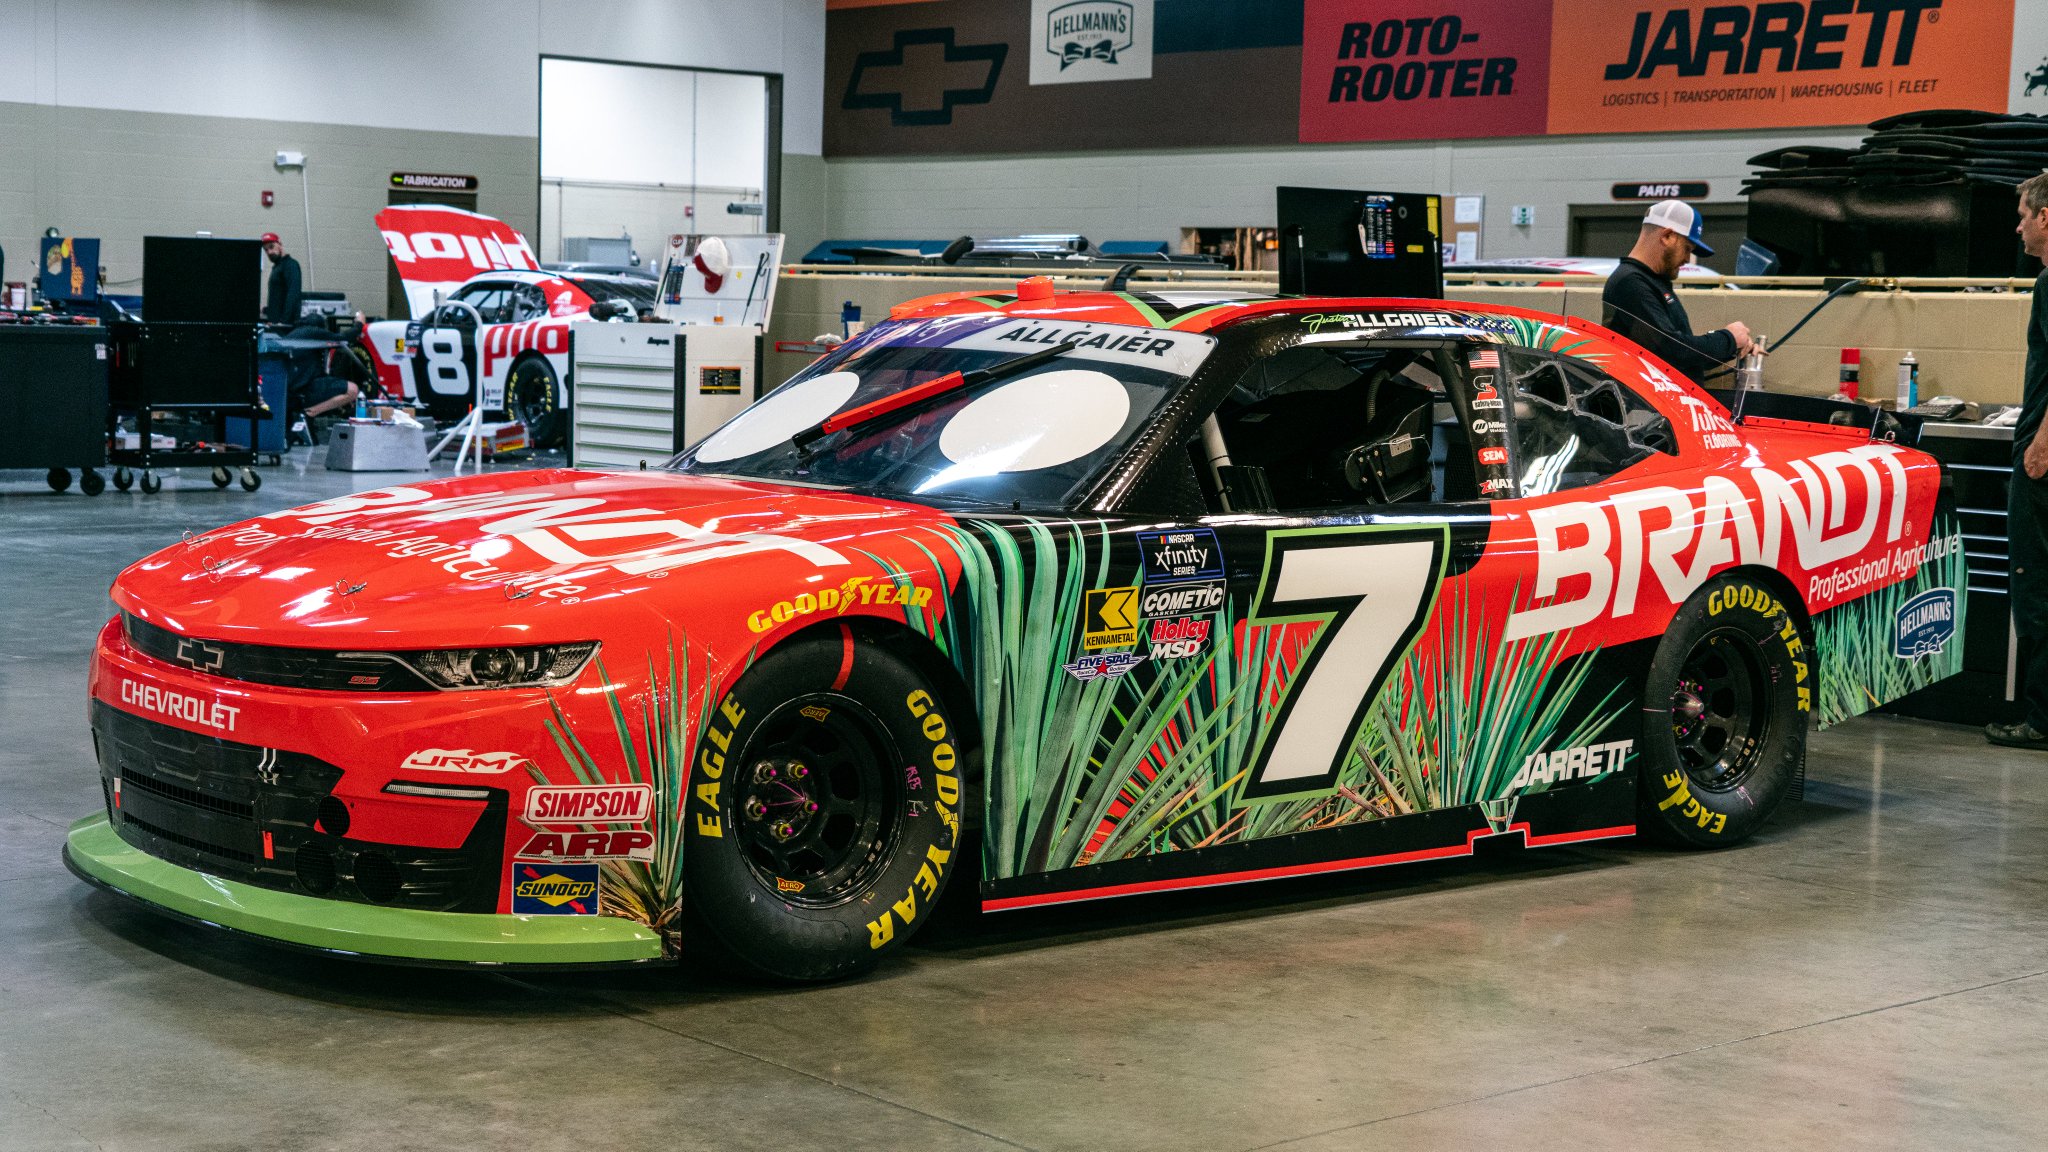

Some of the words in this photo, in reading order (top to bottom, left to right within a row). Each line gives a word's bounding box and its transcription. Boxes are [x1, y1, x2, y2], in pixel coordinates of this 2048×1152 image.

[1053, 8, 1127, 38] HELLMANN'S
[1337, 15, 1480, 60] ROTO-
[1604, 0, 1942, 81] JARRETT
[1328, 57, 1518, 103] ROOTER
[1602, 91, 1659, 107] LOGISTICS
[1672, 87, 1777, 103] TRANSPORTATION
[1790, 81, 1884, 99] WAREHOUSING
[1898, 79, 1939, 94] FLEET
[403, 174, 467, 188] FABRICATION
[1637, 184, 1681, 197] PARTS
[483, 321, 570, 377] pilo
[996, 326, 1175, 357] ALLGAIER
[422, 328, 471, 396] 8
[1679, 395, 1735, 432] Tufco
[1483, 450, 1505, 462] SEM
[1702, 433, 1743, 450] FLOORING
[1168, 534, 1195, 544] NASCAR
[1505, 445, 1911, 643] BRANDT
[1155, 545, 1208, 572] xfinity
[1173, 566, 1196, 576] SERIES
[1808, 550, 1891, 604] Professional
[1891, 533, 1959, 577] Agriculture
[1144, 587, 1224, 613] COMETIC
[1151, 617, 1210, 641] Holley
[1900, 596, 1952, 640] HELLMANN'S
[1086, 633, 1135, 646] KENNAMETAL
[1150, 641, 1201, 661] MSD
[1255, 535, 1440, 793] 7
[122, 678, 241, 732] CHEVROLET
[410, 755, 509, 772] JRM
[697, 691, 746, 839] EAGLE
[1514, 739, 1634, 789] JARRETT
[535, 790, 642, 818] SIMPSON
[1657, 768, 1728, 835] EAGLE
[520, 832, 653, 856] ARP
[520, 883, 593, 897] SUNOCO
